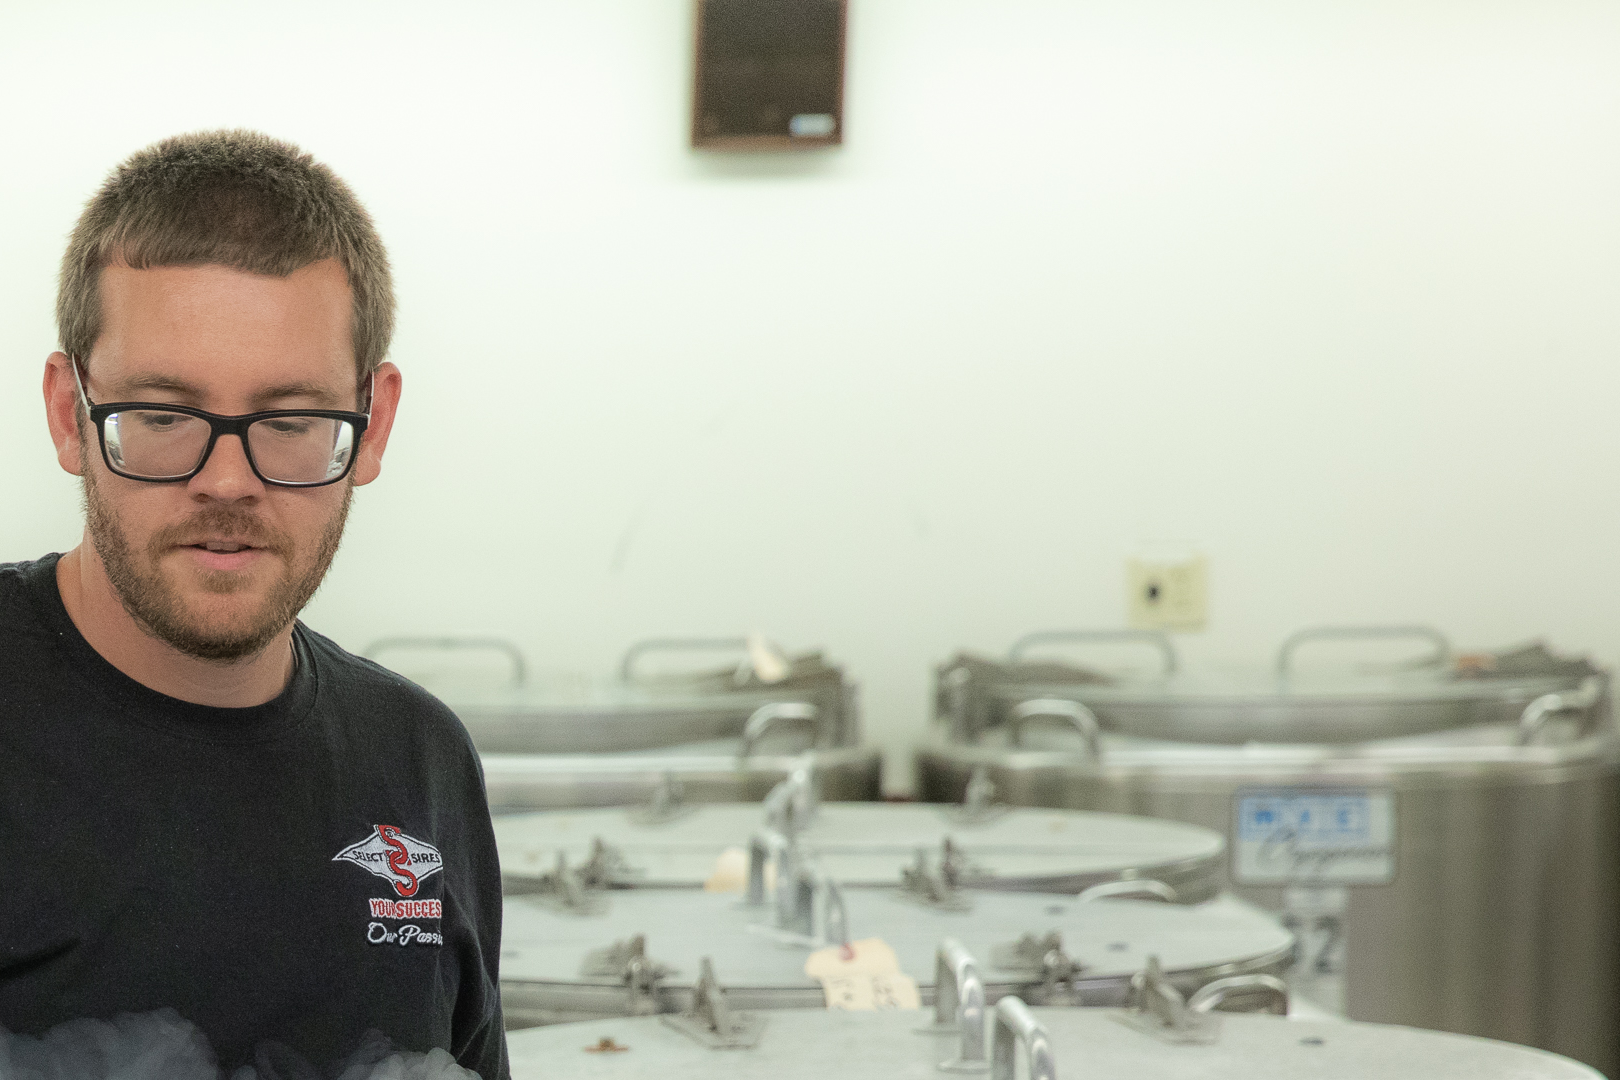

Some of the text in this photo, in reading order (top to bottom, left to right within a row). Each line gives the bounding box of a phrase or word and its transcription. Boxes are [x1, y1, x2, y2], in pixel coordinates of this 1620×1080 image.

[352, 850, 441, 864] SELECT SIRES
[367, 922, 398, 943] Our
